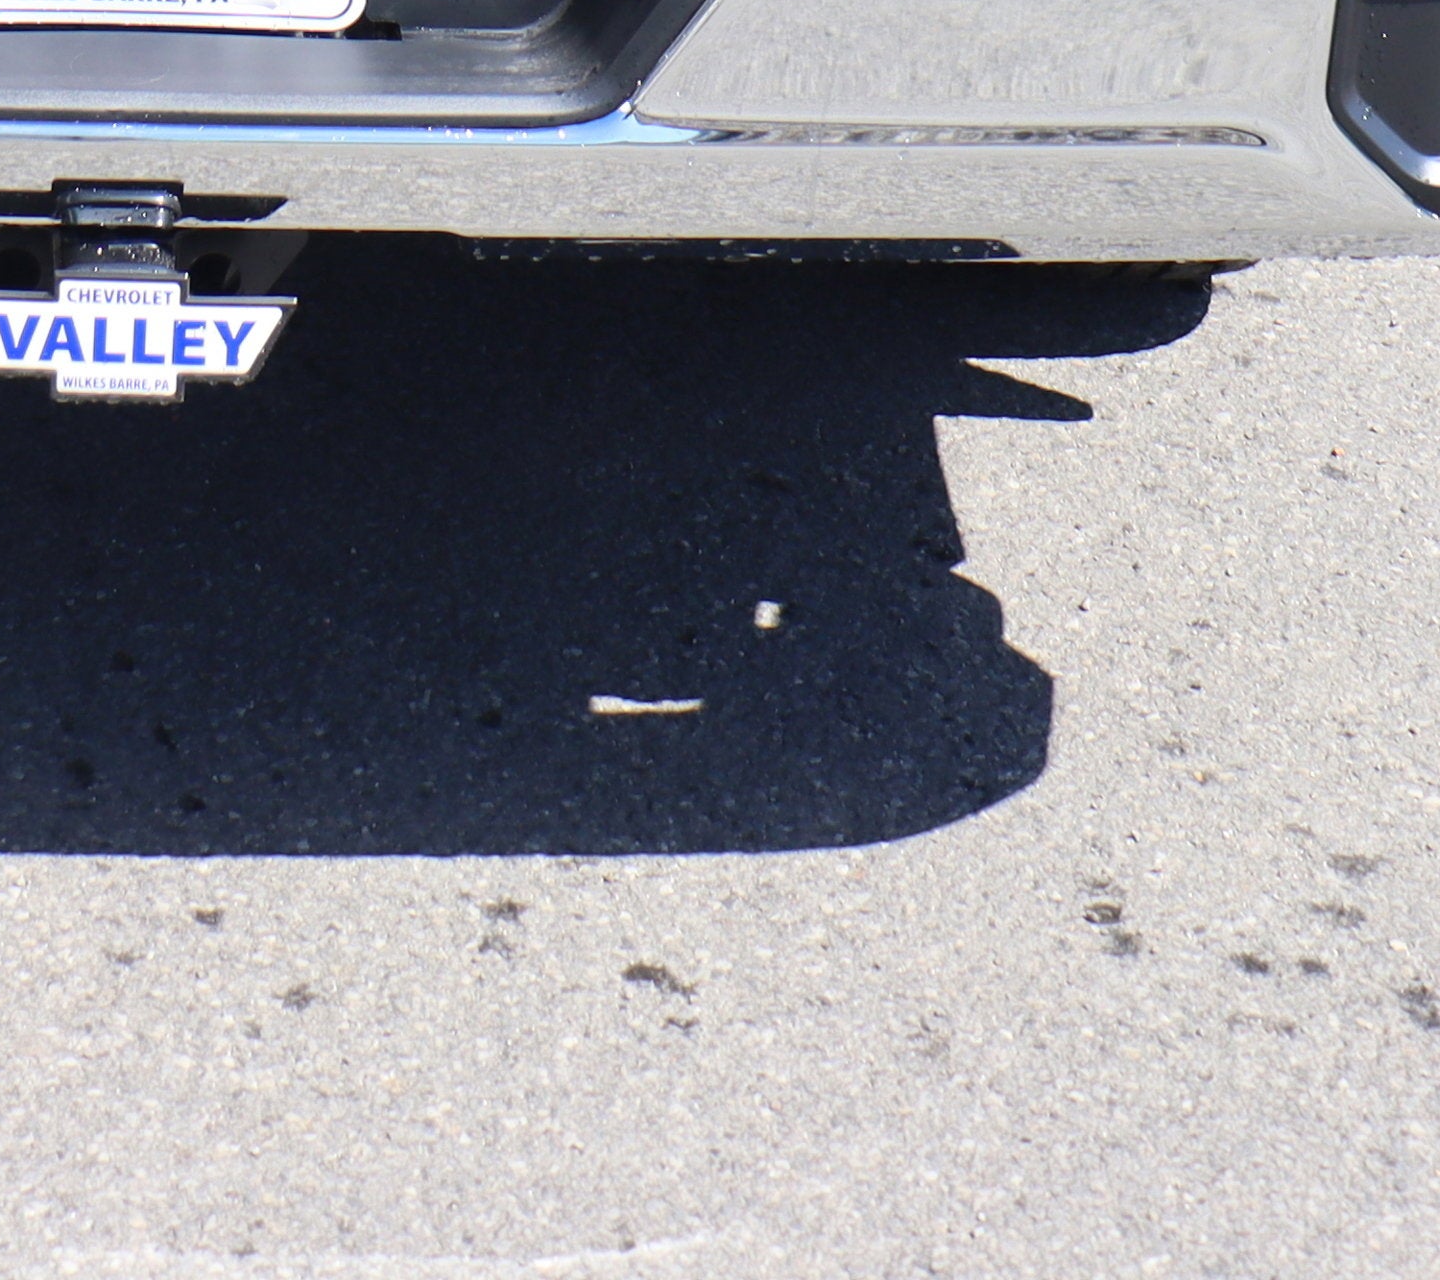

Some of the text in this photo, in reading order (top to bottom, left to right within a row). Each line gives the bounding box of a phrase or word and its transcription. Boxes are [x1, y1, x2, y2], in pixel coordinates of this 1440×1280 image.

[66, 287, 175, 306] CHEVROLET
[62, 376, 170, 392] WILKES BARRE, PA
